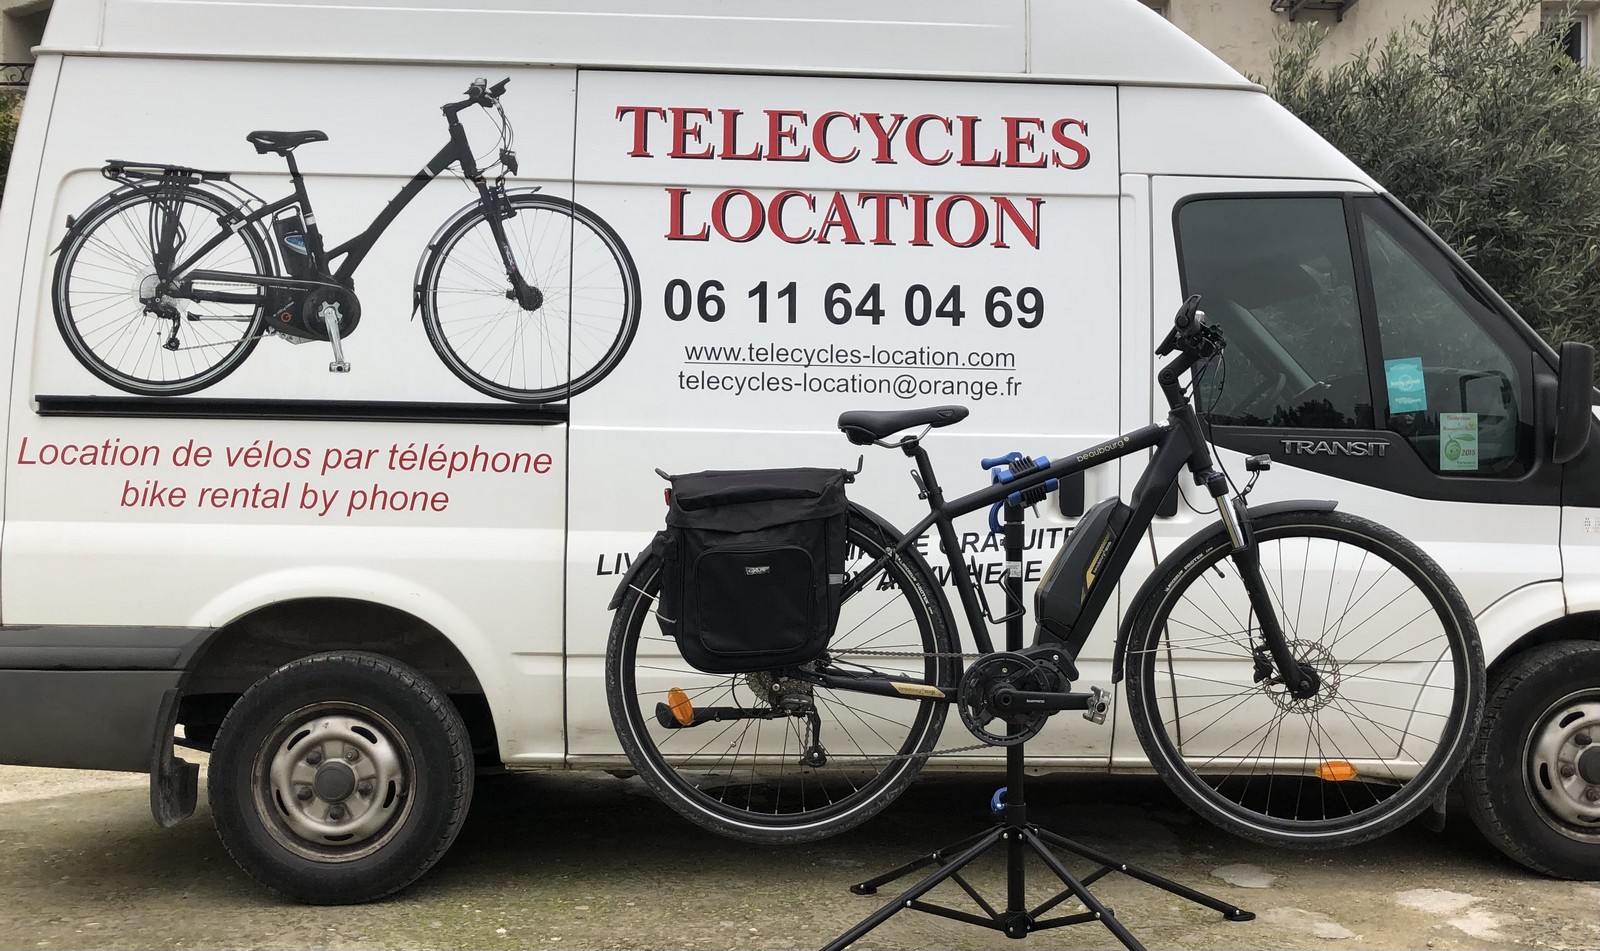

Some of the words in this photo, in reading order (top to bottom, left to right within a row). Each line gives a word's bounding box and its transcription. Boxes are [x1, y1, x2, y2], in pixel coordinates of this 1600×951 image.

[616, 105, 1091, 170] TELECYCLES
[664, 187, 1046, 250] LOCATION
[664, 278, 726, 323] 06
[748, 281, 798, 324] 11
[824, 282, 886, 325] 64
[904, 283, 966, 327] 04
[984, 285, 1045, 329] 69
[684, 343, 1016, 369] www.telecycles-location.com
[678, 370, 1022, 400] telecycles-location@orange.fr
[17, 436, 161, 466] Location
[172, 439, 213, 468] de
[225, 440, 312, 470] vélos
[320, 447, 380, 476] par
[387, 442, 553, 479] téléphone
[1076, 440, 1125, 463] beaubourg
[1281, 439, 1391, 457] TRANSIT
[120, 479, 187, 508] bike
[198, 482, 291, 510] rental
[299, 482, 339, 517] by
[346, 483, 450, 518] phone
